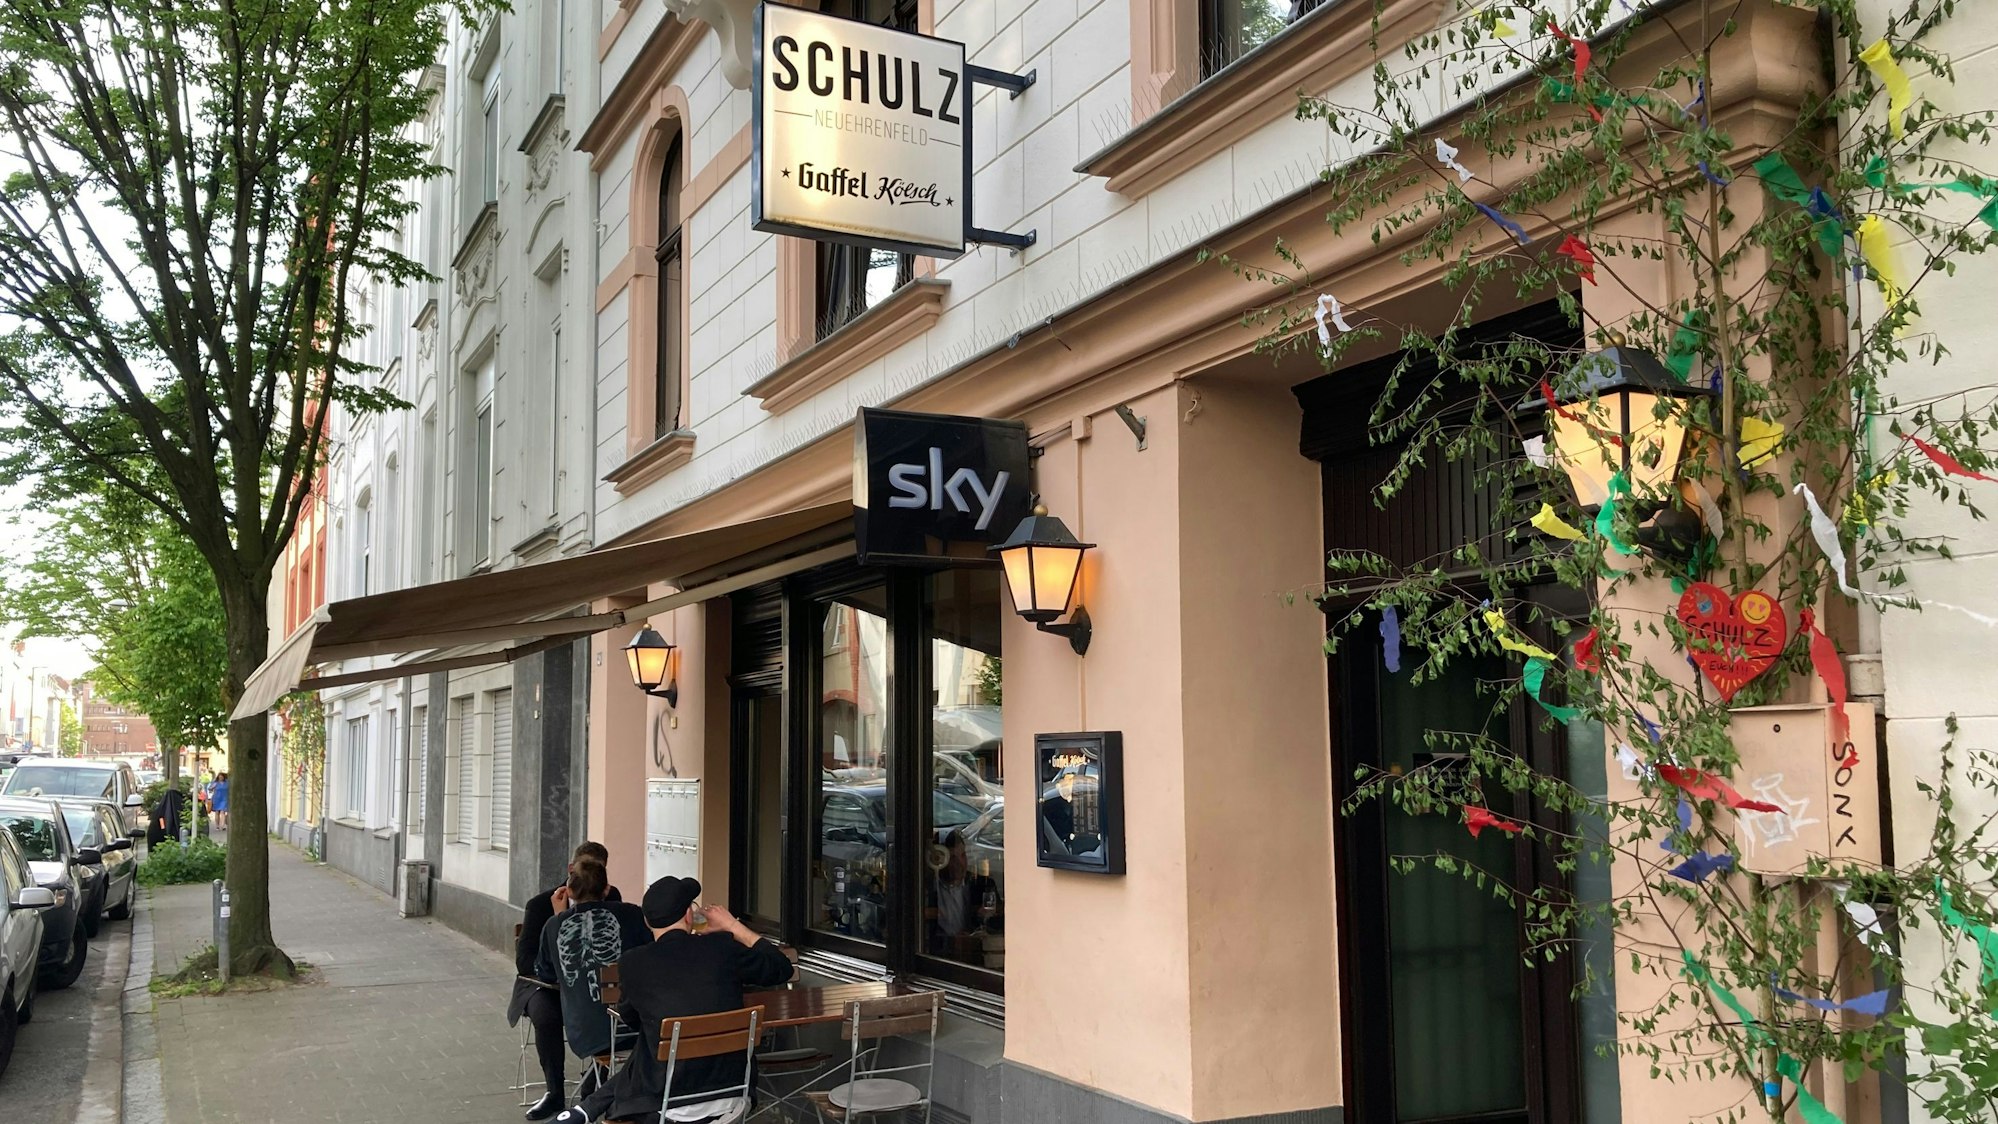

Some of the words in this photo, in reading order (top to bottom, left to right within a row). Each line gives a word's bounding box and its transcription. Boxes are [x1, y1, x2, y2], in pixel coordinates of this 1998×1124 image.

[772, 35, 960, 125] SCHULZ
[814, 108, 928, 147] NEUEHRENFELD
[798, 162, 869, 199] Gaffel
[874, 176, 941, 207] Kölsch
[888, 446, 1011, 530] sky
[1685, 615, 1773, 647] SCHULZ
